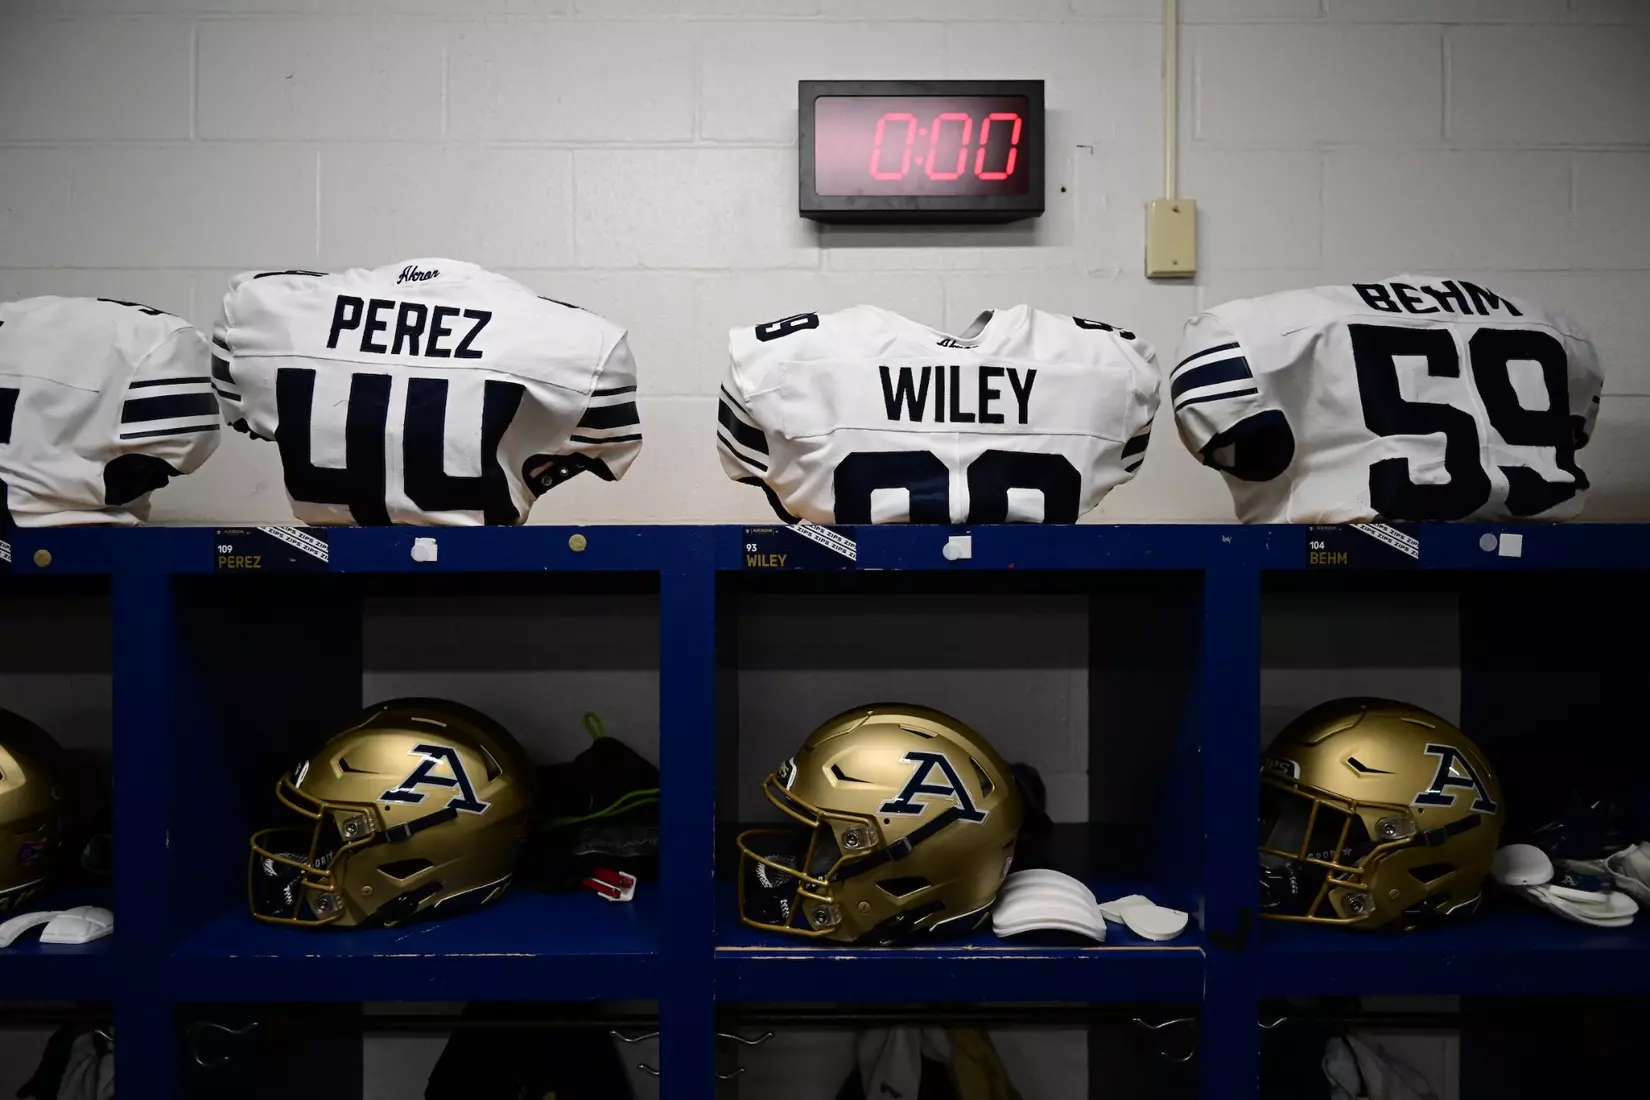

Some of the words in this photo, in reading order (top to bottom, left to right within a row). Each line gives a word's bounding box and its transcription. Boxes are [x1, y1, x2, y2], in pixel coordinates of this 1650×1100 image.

[869, 112, 1022, 181] 0:00
[326, 294, 493, 359] PEREZ
[1352, 280, 1524, 317] BEHM
[879, 364, 1037, 425] WILEY
[1347, 323, 1579, 521] 59
[275, 367, 526, 526] 44
[217, 544, 233, 553] 109
[218, 555, 261, 569] PEREZ
[746, 543, 758, 552] 93
[746, 553, 787, 567] WILEY
[1309, 541, 1325, 550] 104
[1310, 551, 1348, 565] BEHM
[378, 743, 492, 816] A
[876, 750, 990, 826] A
[1410, 743, 1498, 816] A
